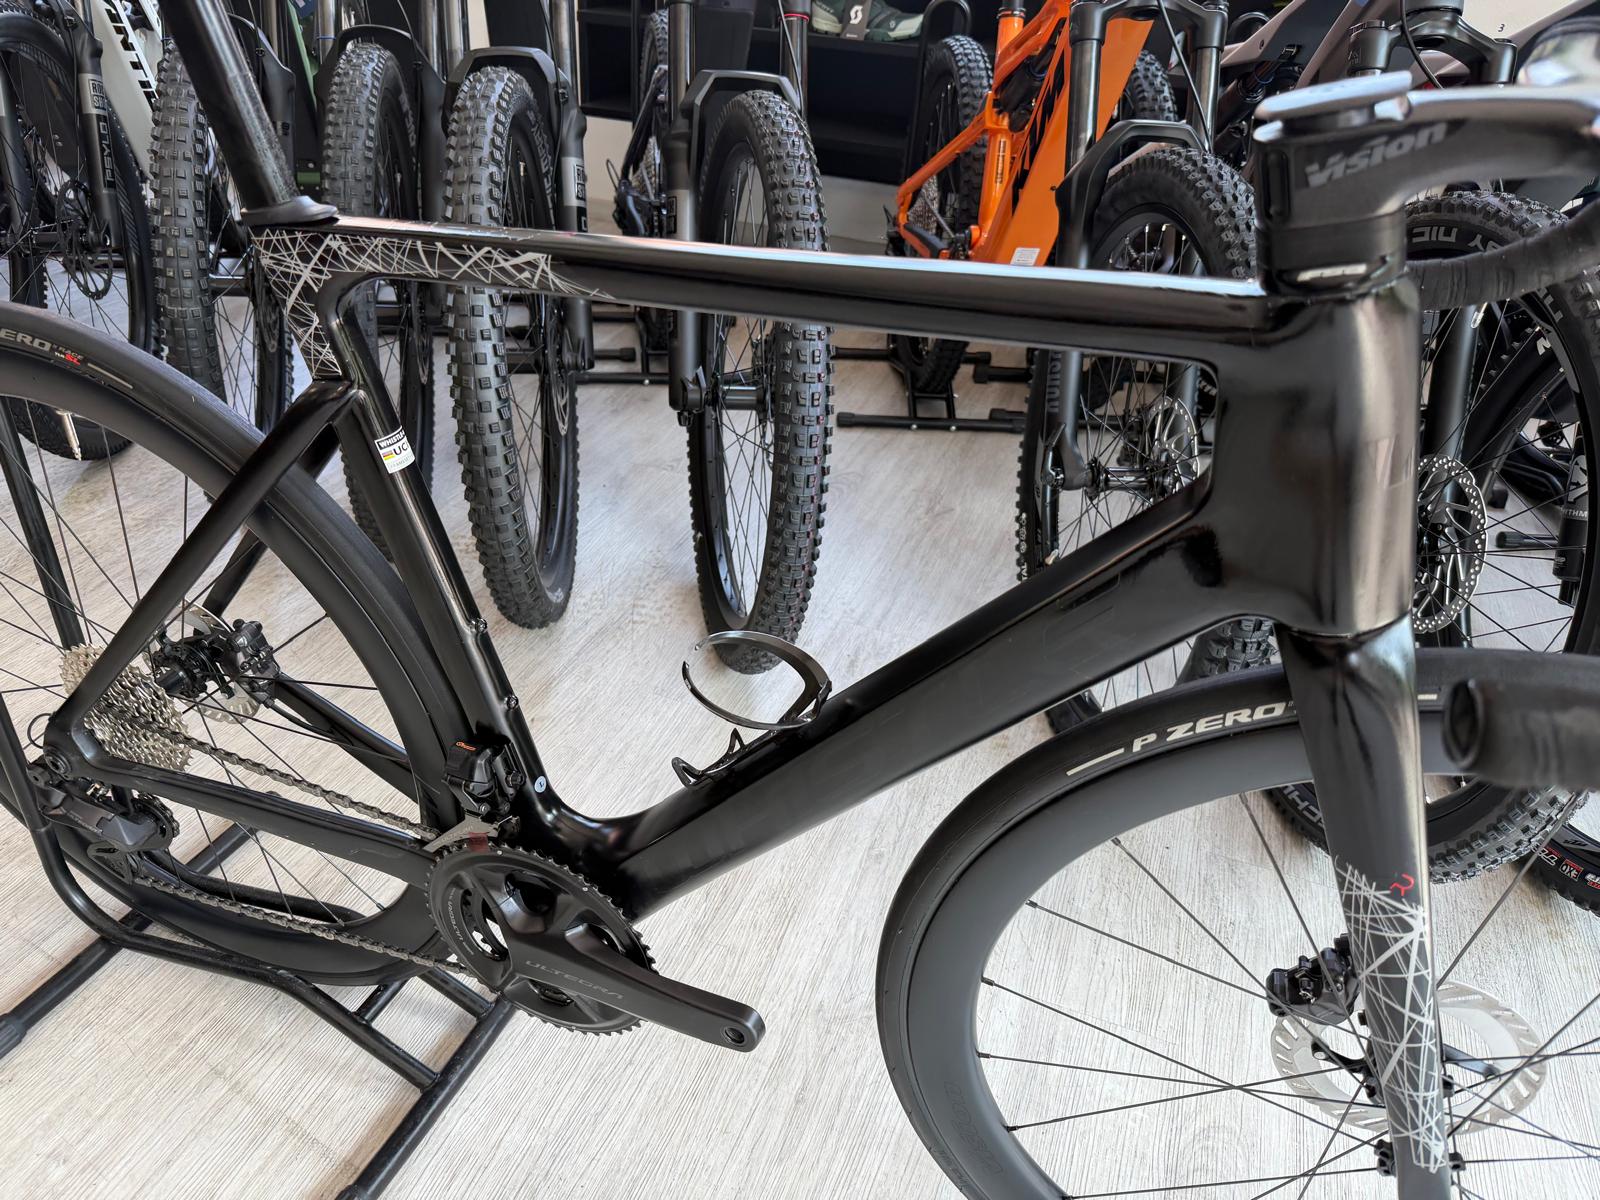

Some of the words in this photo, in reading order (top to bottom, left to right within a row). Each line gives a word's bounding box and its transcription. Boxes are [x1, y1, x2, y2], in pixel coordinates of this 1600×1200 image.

[100, 121, 115, 181] PSYLO
[1304, 122, 1448, 188] Vision
[1411, 226, 1458, 244] NIC
[1132, 733, 1157, 753] P
[1166, 701, 1287, 742] ZERO
[525, 960, 625, 1000] ULTEGRA
